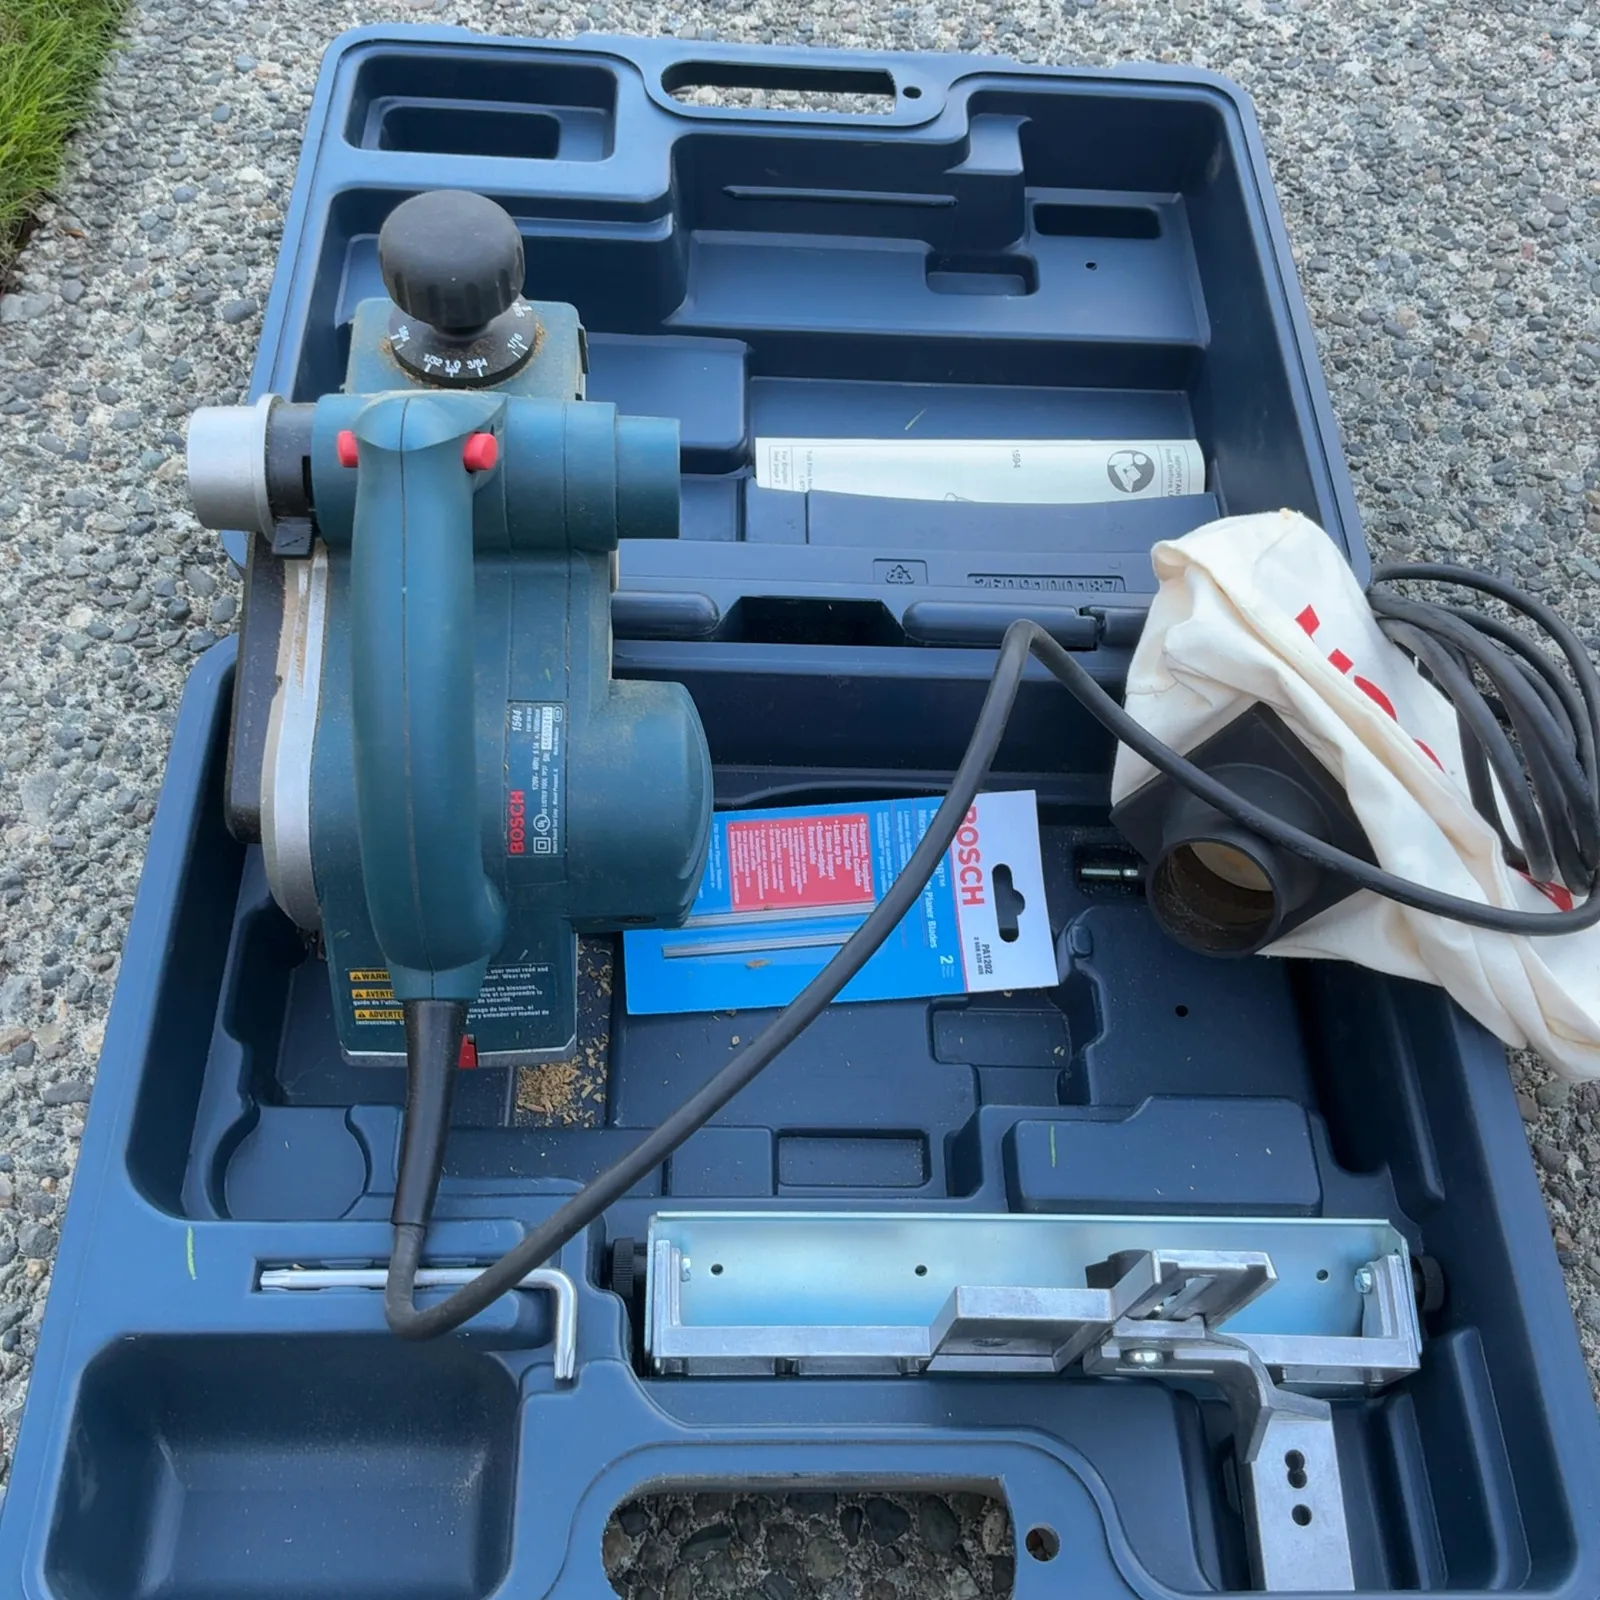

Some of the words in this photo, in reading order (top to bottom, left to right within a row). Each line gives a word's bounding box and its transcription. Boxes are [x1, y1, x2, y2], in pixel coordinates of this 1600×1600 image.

[1012, 449, 1021, 468] 1594
[512, 709, 522, 732] 1594
[510, 791, 525, 854] BOSCH
[834, 846, 841, 855] up
[925, 891, 936, 918] Planer
[928, 921, 938, 948] Blades
[940, 955, 954, 964] 2
[982, 943, 993, 974] PA1202
